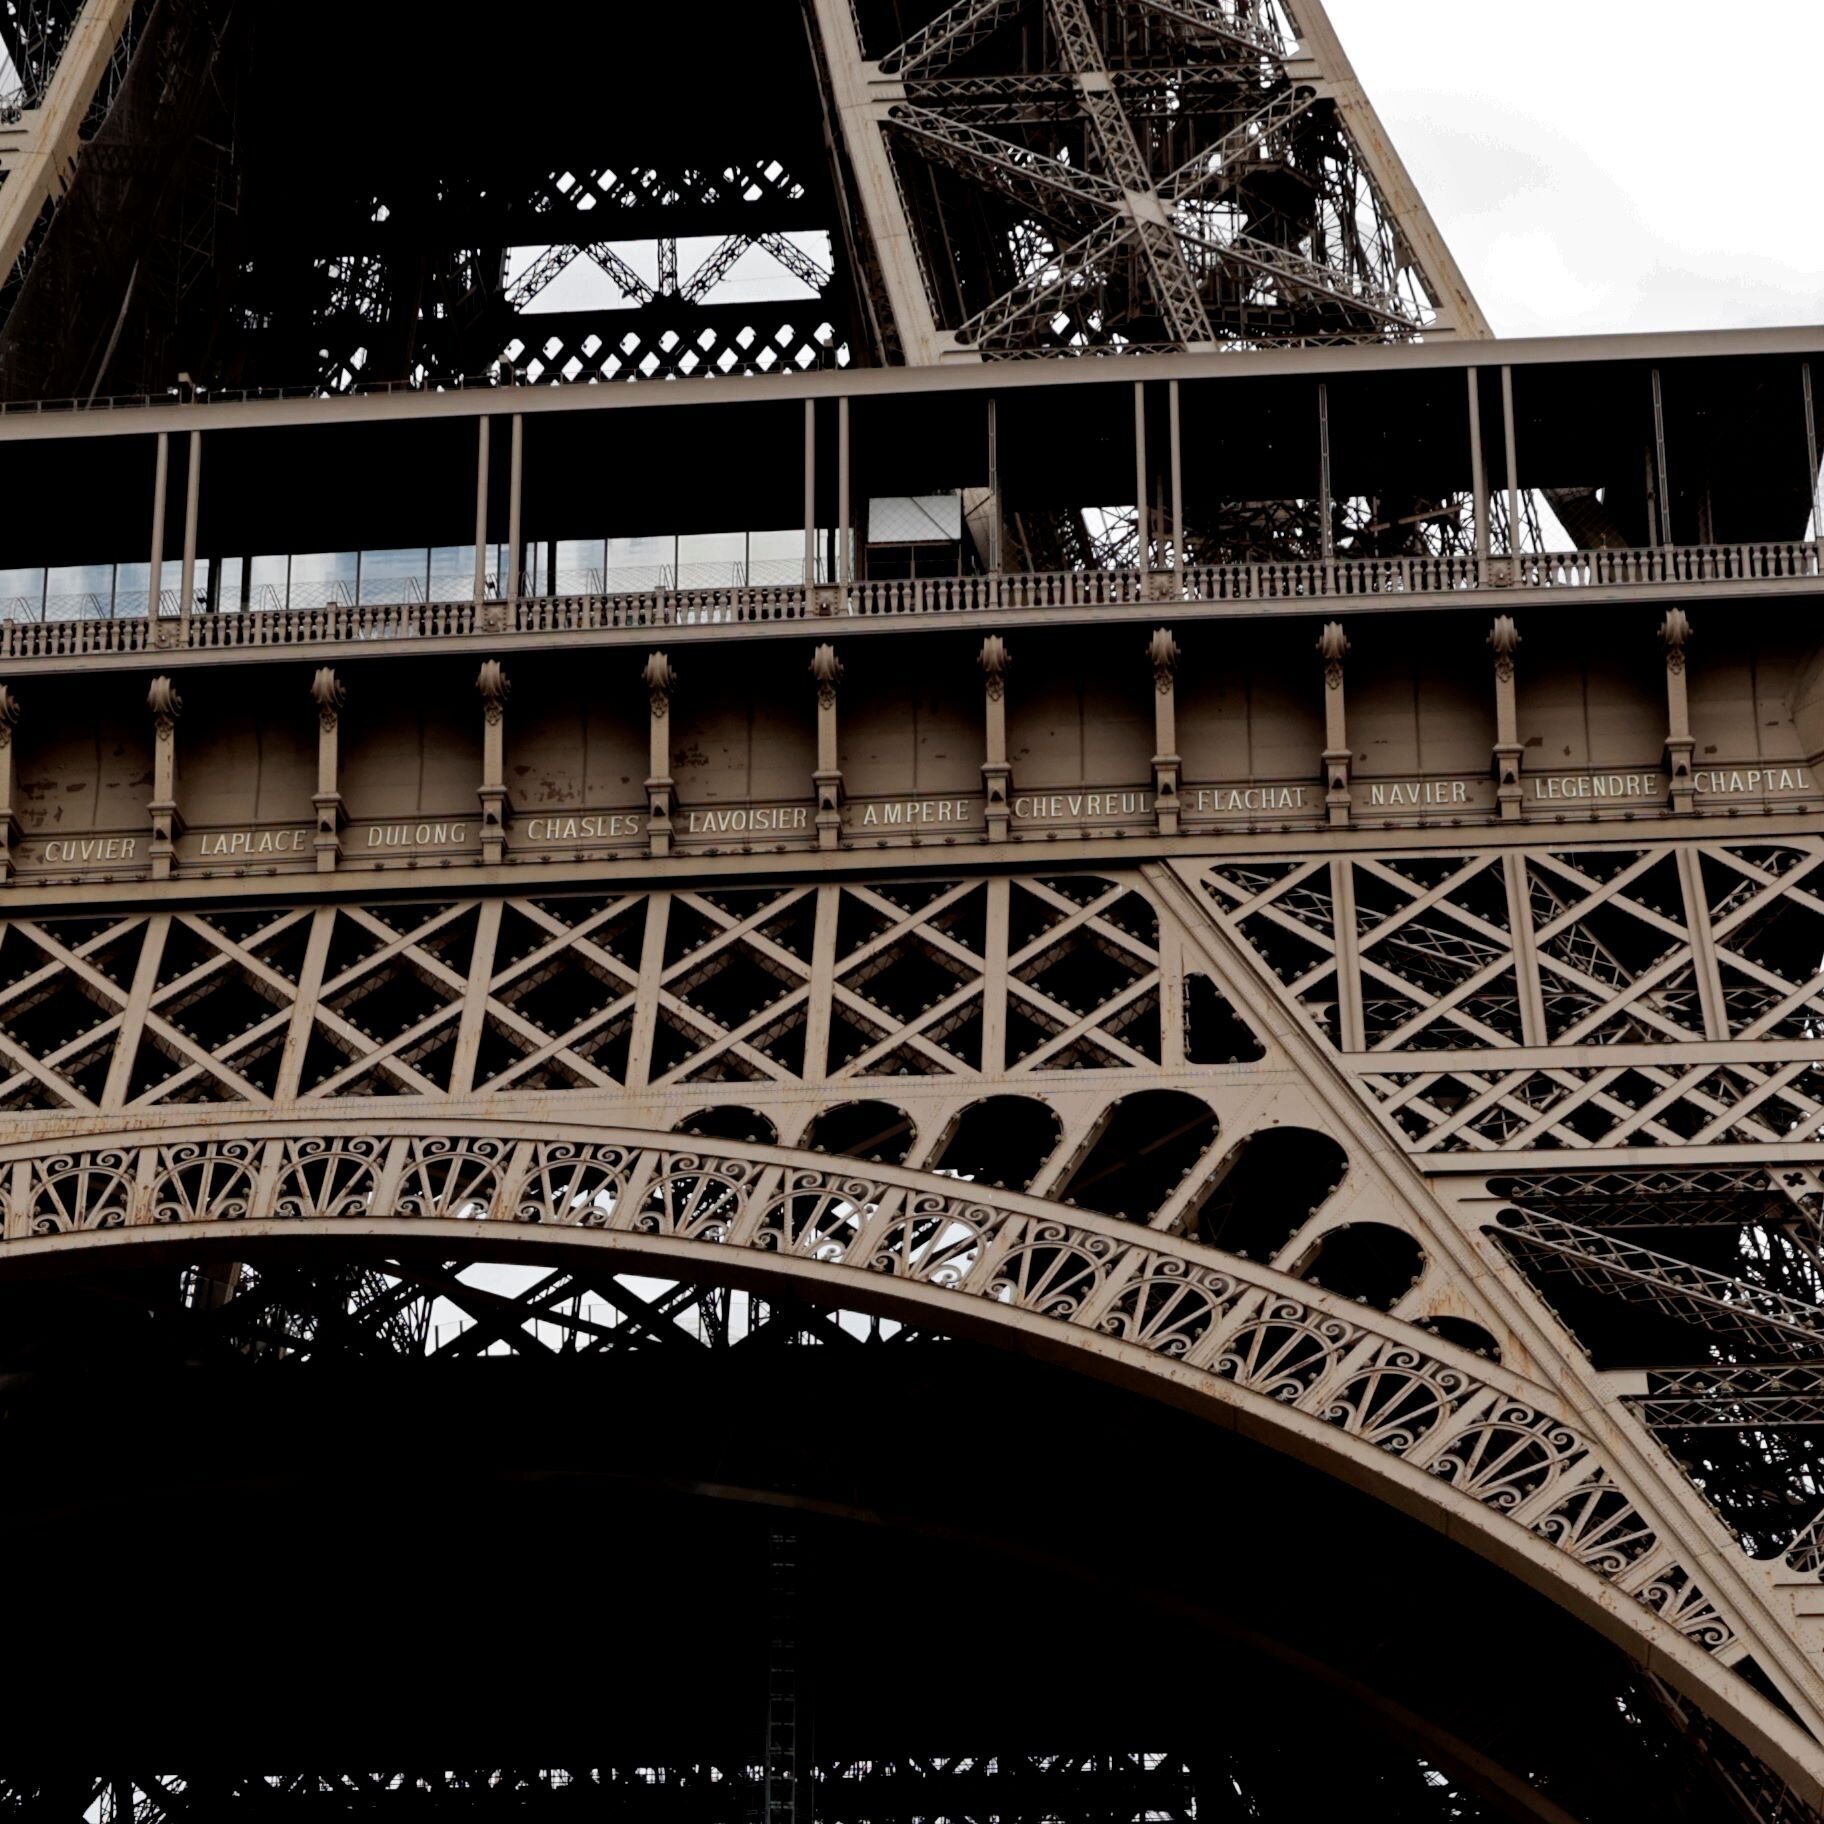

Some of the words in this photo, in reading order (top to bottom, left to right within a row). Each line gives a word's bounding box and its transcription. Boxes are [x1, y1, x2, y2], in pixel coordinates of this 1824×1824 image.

[1371, 781, 1466, 805] NAVIER
[1536, 774, 1657, 799] LEGENDRE
[1694, 768, 1809, 793] CHAPTAL
[1015, 793, 1150, 818] CHEVREUL
[1197, 787, 1306, 811] FLACHAT
[689, 808, 807, 833] LAVOISIER
[863, 800, 969, 826] AMPERE
[367, 823, 466, 847] DULONG
[528, 815, 639, 840] CHASLES
[45, 838, 136, 862] CUVIER
[200, 830, 307, 856] LAPLACE
